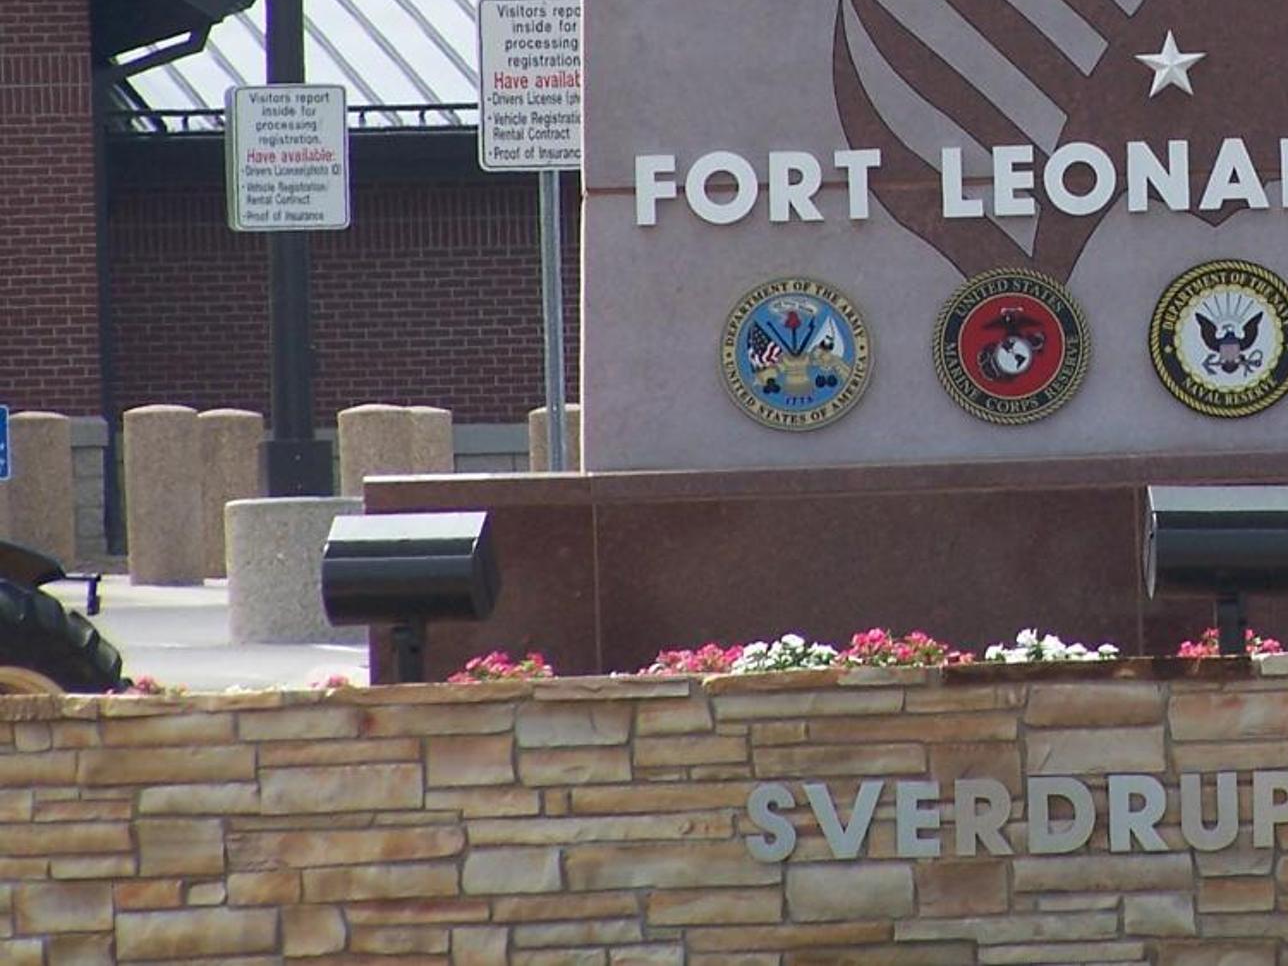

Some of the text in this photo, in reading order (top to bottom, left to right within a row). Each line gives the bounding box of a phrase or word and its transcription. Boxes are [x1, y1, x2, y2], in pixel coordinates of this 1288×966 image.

[497, 5, 547, 18] Visitors
[512, 21, 577, 33] inside for
[505, 37, 579, 52] processing
[494, 71, 529, 89] Have
[249, 93, 330, 105] Visitors report
[492, 92, 523, 105] Drivers
[527, 91, 562, 105] License
[262, 106, 316, 116] inside for
[493, 112, 527, 125] Vehicle
[256, 121, 317, 132] processing
[493, 127, 570, 141] Rental Contract
[247, 149, 276, 163] Have
[494, 146, 521, 160] Proof
[525, 146, 535, 159] of
[635, 148, 882, 226] FORT
[956, 279, 1064, 318] UNITED STATES
[1162, 273, 1227, 331] DEPARTMENT
[1230, 272, 1247, 284] OF
[1249, 274, 1273, 296] THE
[725, 281, 788, 348] DEPARTMENT
[793, 279, 812, 292] OF
[815, 282, 839, 305] THE
[838, 299, 866, 337] ARMY
[944, 335, 1079, 413] MARINE CORPS RESERVE
[725, 355, 867, 424] UNITED STATES OF AMERICA
[1183, 377, 1277, 406] NAVAL RESERVE
